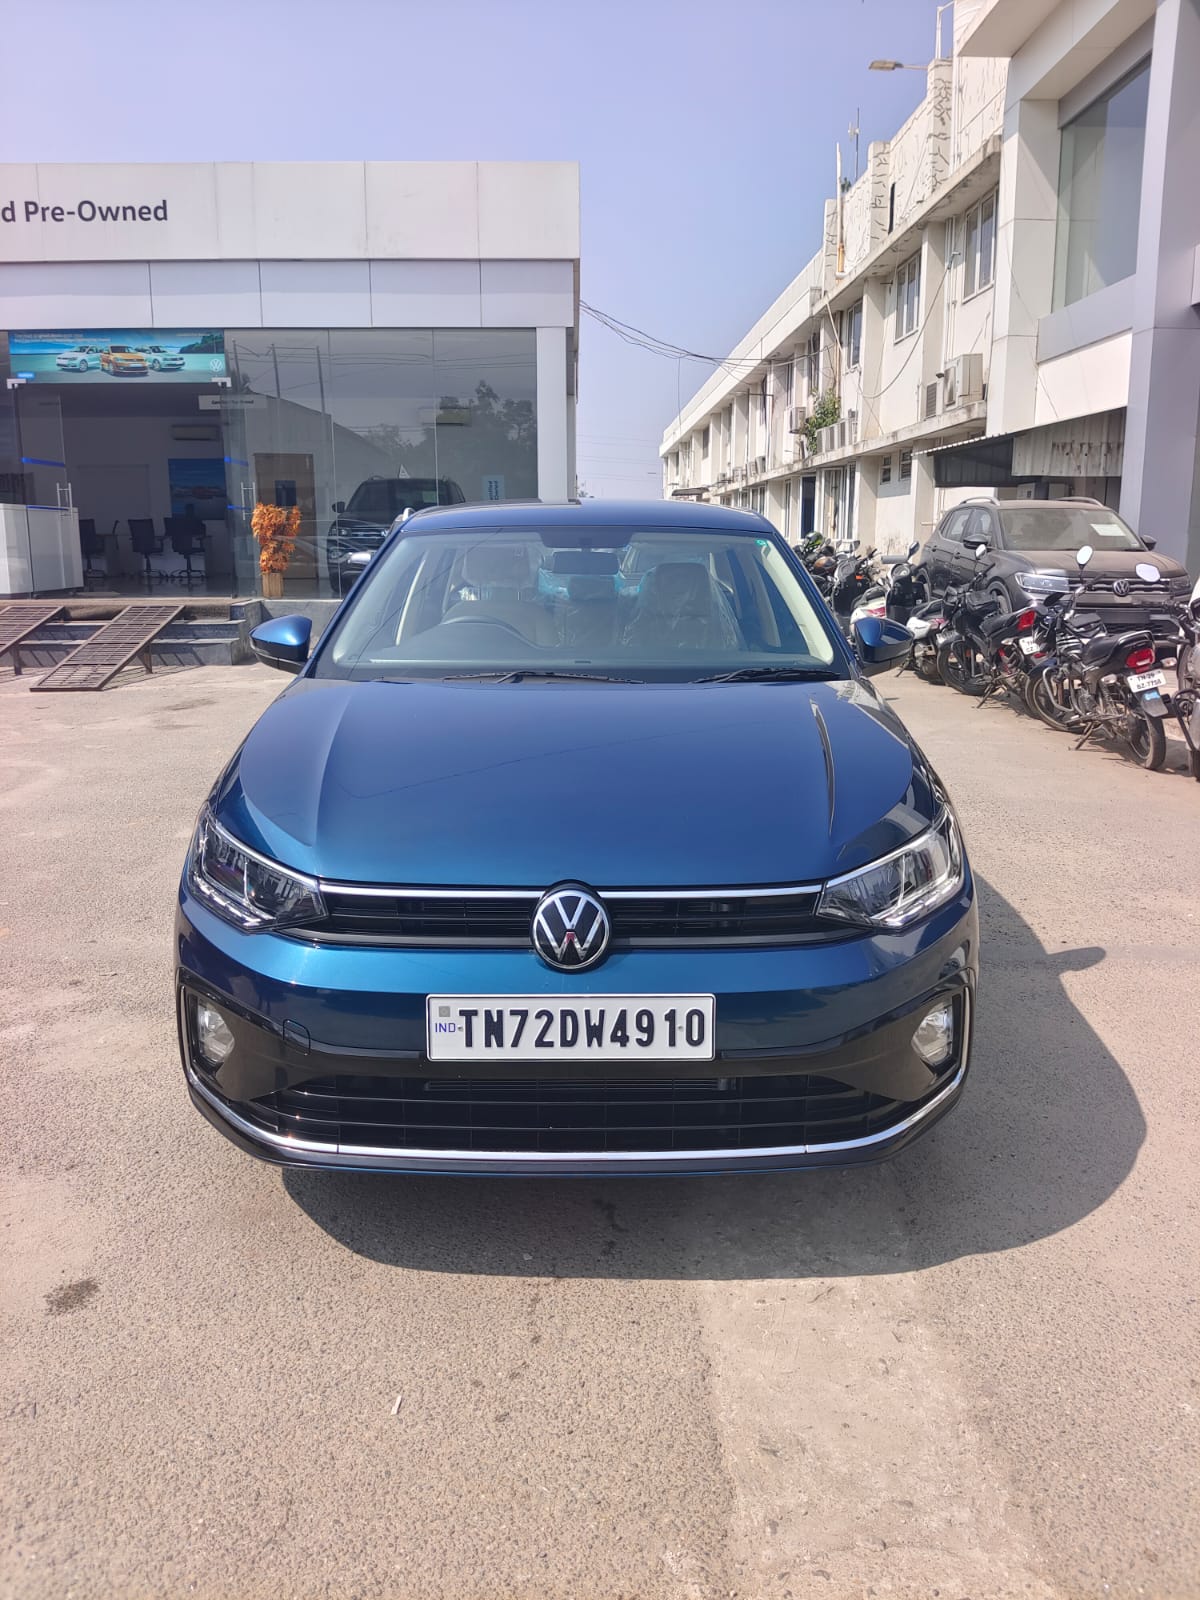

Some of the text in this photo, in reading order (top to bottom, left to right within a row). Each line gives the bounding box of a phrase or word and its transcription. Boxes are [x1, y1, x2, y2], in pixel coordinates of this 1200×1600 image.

[24, 199, 168, 222] Pre-Owned
[535, 893, 608, 966] VW
[434, 1022, 456, 1033] IND
[457, 1008, 706, 1048] TN72DW4910
